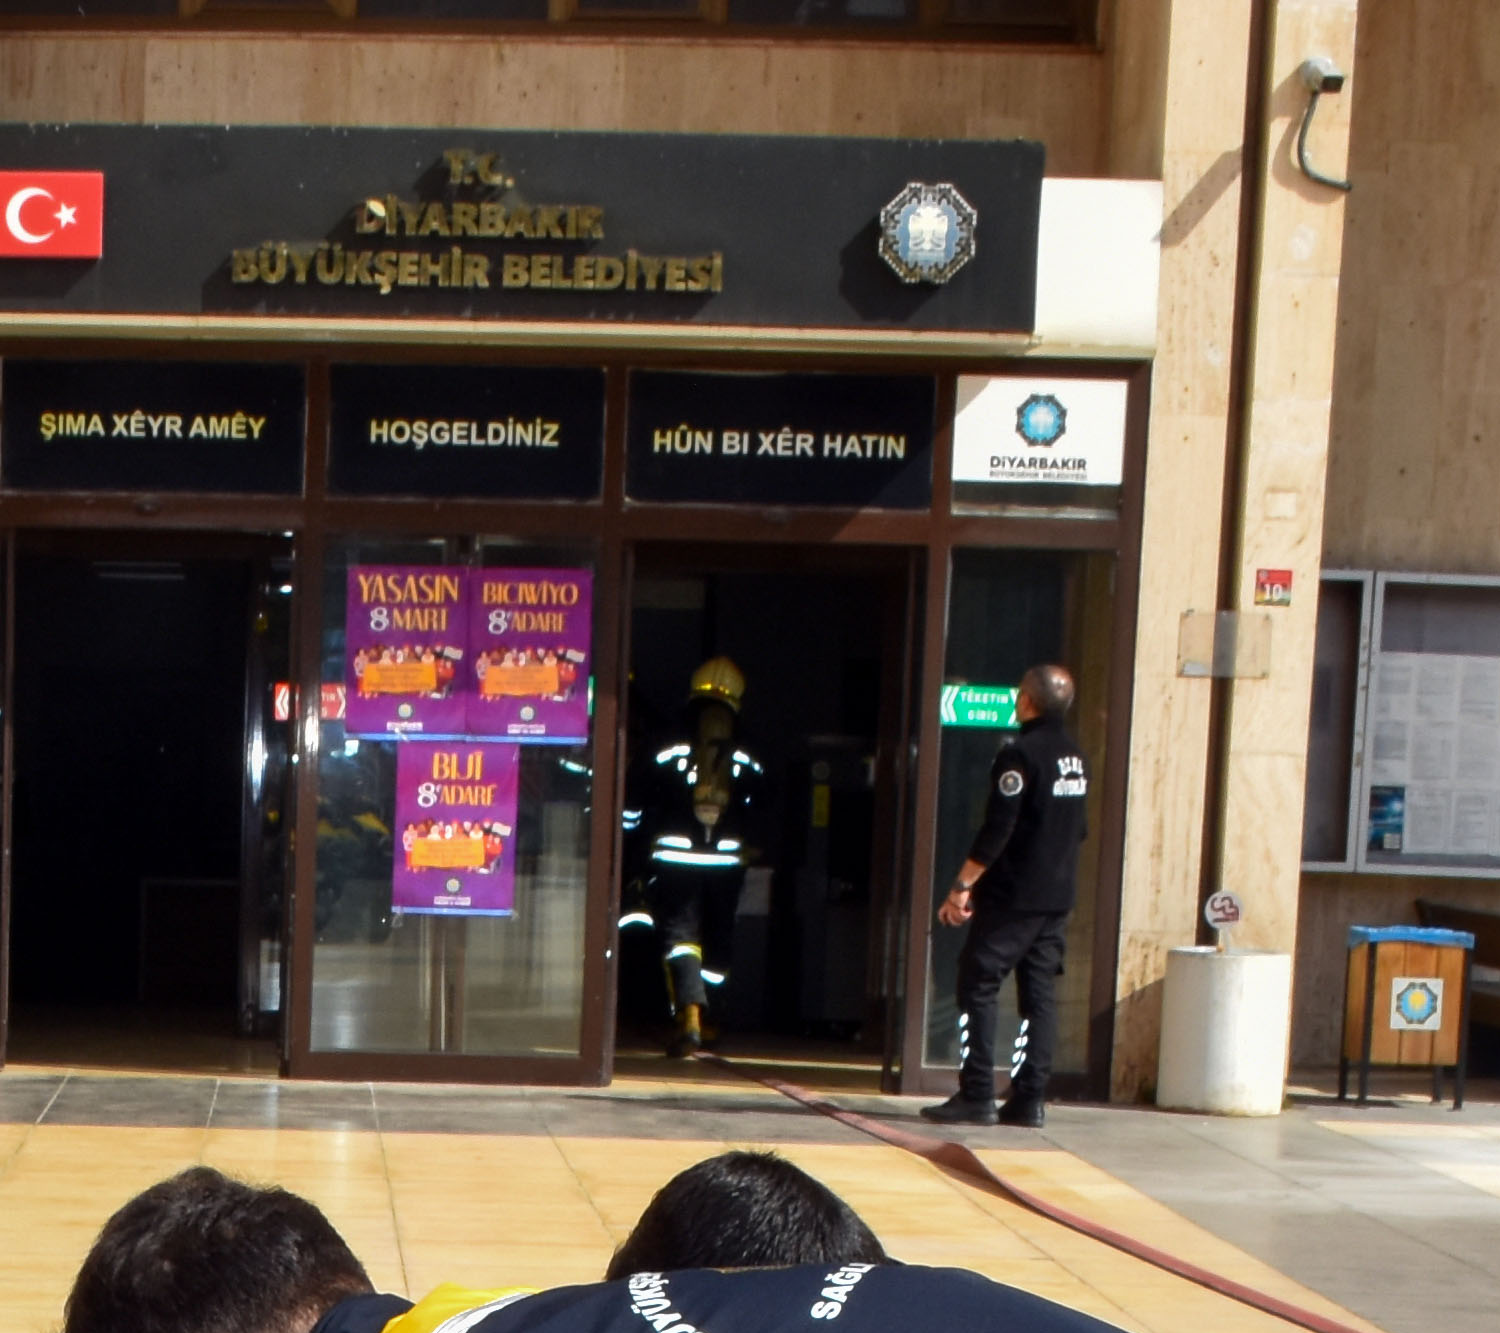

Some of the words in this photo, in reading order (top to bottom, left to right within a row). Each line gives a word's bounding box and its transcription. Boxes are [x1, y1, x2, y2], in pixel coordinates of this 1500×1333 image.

[443, 148, 515, 189] T.C.
[354, 194, 605, 239] DİYARBAKIR
[231, 241, 490, 295] BÜYÜKŞEHİR
[502, 247, 725, 293] BELEDİYESİ
[39, 414, 105, 442] ŞIMA
[112, 410, 183, 438] XÊYR
[188, 410, 267, 440] AMÊY
[369, 418, 560, 449] HOŞGELDİNİZ
[652, 425, 714, 455] HÛN
[755, 427, 815, 456] XÊR
[823, 434, 907, 459] HATIN
[989, 455, 1087, 471] DİYARBAKIR
[1263, 583, 1283, 601] 10
[370, 606, 389, 631] 8
[393, 607, 448, 632] MART
